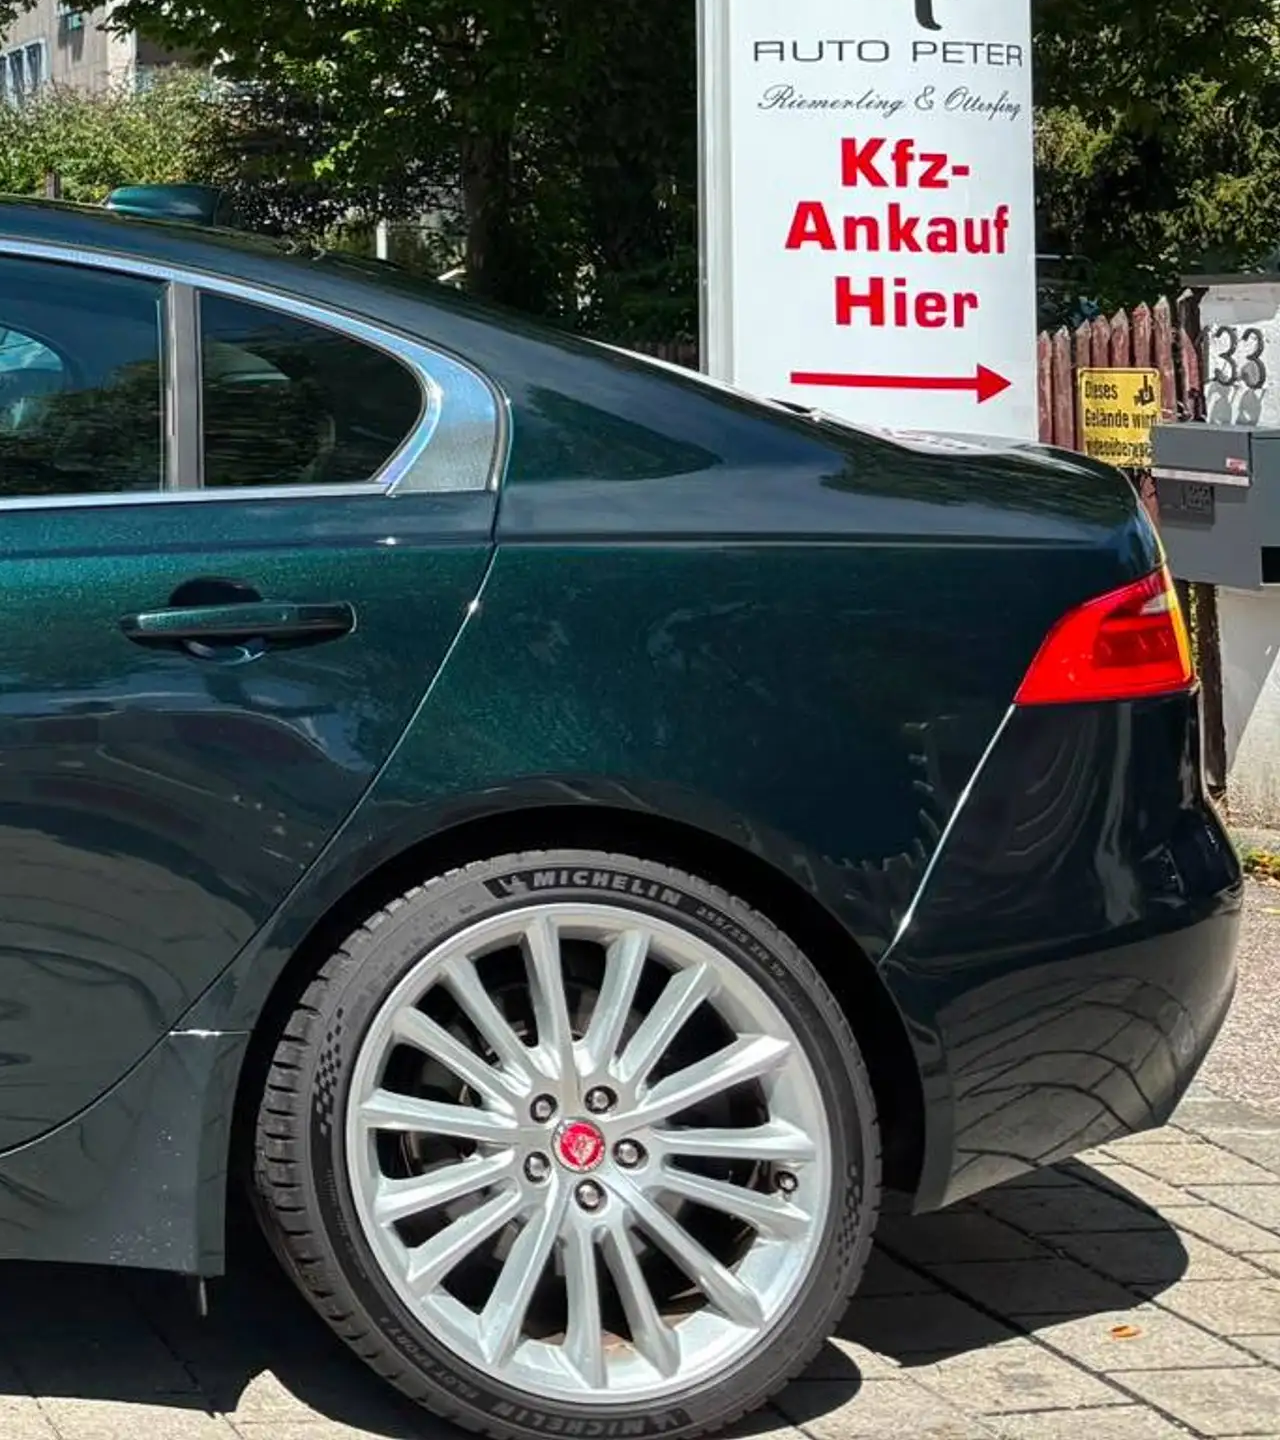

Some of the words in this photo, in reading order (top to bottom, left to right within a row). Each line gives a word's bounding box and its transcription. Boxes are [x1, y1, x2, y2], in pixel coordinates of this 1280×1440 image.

[753, 39, 890, 62] AUTO
[912, 41, 1023, 67] PETER
[757, 84, 904, 119] Riemerling
[914, 85, 936, 111] &
[943, 86, 1023, 121] Otterfing
[841, 137, 970, 188] Kfz-
[785, 200, 1009, 254] Ankauf
[835, 275, 979, 328] Hier
[533, 870, 682, 905] MICHELIN
[491, 1401, 647, 1436] MICHELIN
